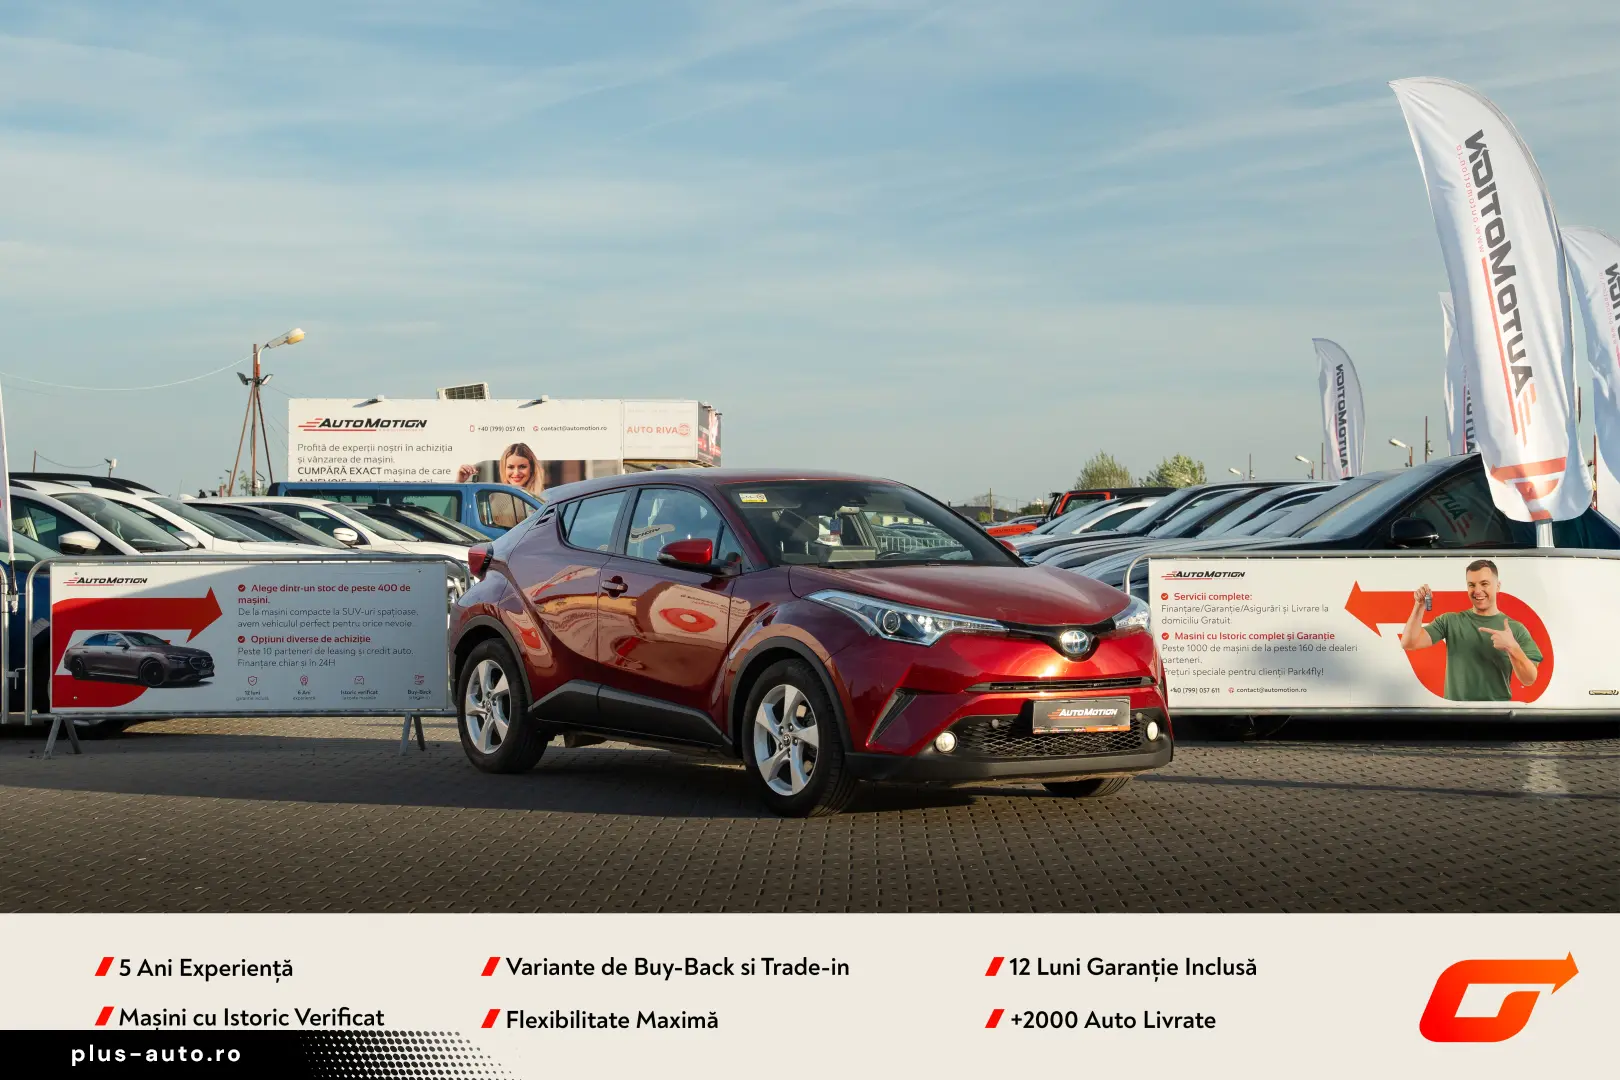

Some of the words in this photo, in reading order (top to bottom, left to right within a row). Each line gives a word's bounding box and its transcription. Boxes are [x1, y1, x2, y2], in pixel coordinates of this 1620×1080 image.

[489, 425, 504, 433] (799)
[627, 426, 653, 434] AUTO
[297, 443, 327, 452] Profită
[329, 443, 340, 452] de
[342, 443, 376, 454] experții
[378, 443, 403, 454] noștri
[405, 443, 414, 452] în
[416, 443, 453, 454] achiziția
[297, 456, 306, 465] și
[308, 455, 348, 464] vânzarea
[350, 456, 361, 464] de
[363, 456, 396, 466] mașini.
[297, 466, 348, 475] CUMPĂRĂ
[349, 467, 382, 475] EXACT
[384, 467, 417, 477] mașina
[419, 466, 430, 475] de
[251, 584, 278, 594] Alege
[280, 584, 315, 592] dintr-un
[317, 584, 336, 592] stoc
[338, 584, 349, 592] de
[351, 585, 376, 594] peste
[378, 584, 398, 592] 400
[399, 584, 411, 592] de
[238, 596, 270, 606] mașini.
[1174, 593, 1207, 601] Servicii
[1208, 593, 1253, 602] complete:
[238, 608, 251, 616] De
[252, 608, 260, 616] la
[290, 608, 331, 618] compacte
[332, 608, 340, 616] la
[342, 608, 376, 616] SUV-uri
[1283, 605, 1289, 615] și
[1291, 605, 1320, 613] Livrare
[1322, 605, 1329, 613] la
[262, 619, 298, 628] vehiculul
[300, 619, 330, 629] perfect
[332, 620, 360, 629] pentru
[362, 620, 383, 628] orice
[1161, 616, 1199, 625] domiciliu
[251, 634, 284, 645] Opțiuni
[286, 635, 319, 643] diverse
[320, 634, 332, 643] de
[334, 634, 371, 645] achiziție
[1220, 632, 1247, 640] Istoric
[1248, 632, 1285, 642] complet
[1286, 632, 1295, 643] și
[1296, 632, 1335, 643] Garanție
[238, 647, 261, 656] Peste
[263, 648, 273, 656] 10
[274, 647, 312, 657] parteneri
[314, 647, 325, 656] de
[327, 647, 356, 657] leasing
[366, 647, 391, 656] credit
[1162, 644, 1185, 652] Peste
[1187, 644, 1208, 652] 1000
[1209, 644, 1221, 652] de
[1223, 644, 1250, 654] mașini
[1251, 644, 1263, 652] de
[1264, 644, 1272, 652] la
[1273, 645, 1297, 654] peste
[1299, 644, 1314, 652] 160
[1315, 644, 1327, 652] de
[1328, 644, 1358, 652] dealeri
[278, 659, 299, 667] chiar
[318, 659, 336, 667] 24H
[1192, 668, 1226, 677] speciale
[1228, 668, 1256, 677] pentru
[1258, 668, 1286, 678] clienții
[1288, 667, 1324, 678] Park4fly!
[1182, 687, 1198, 695] (799)
